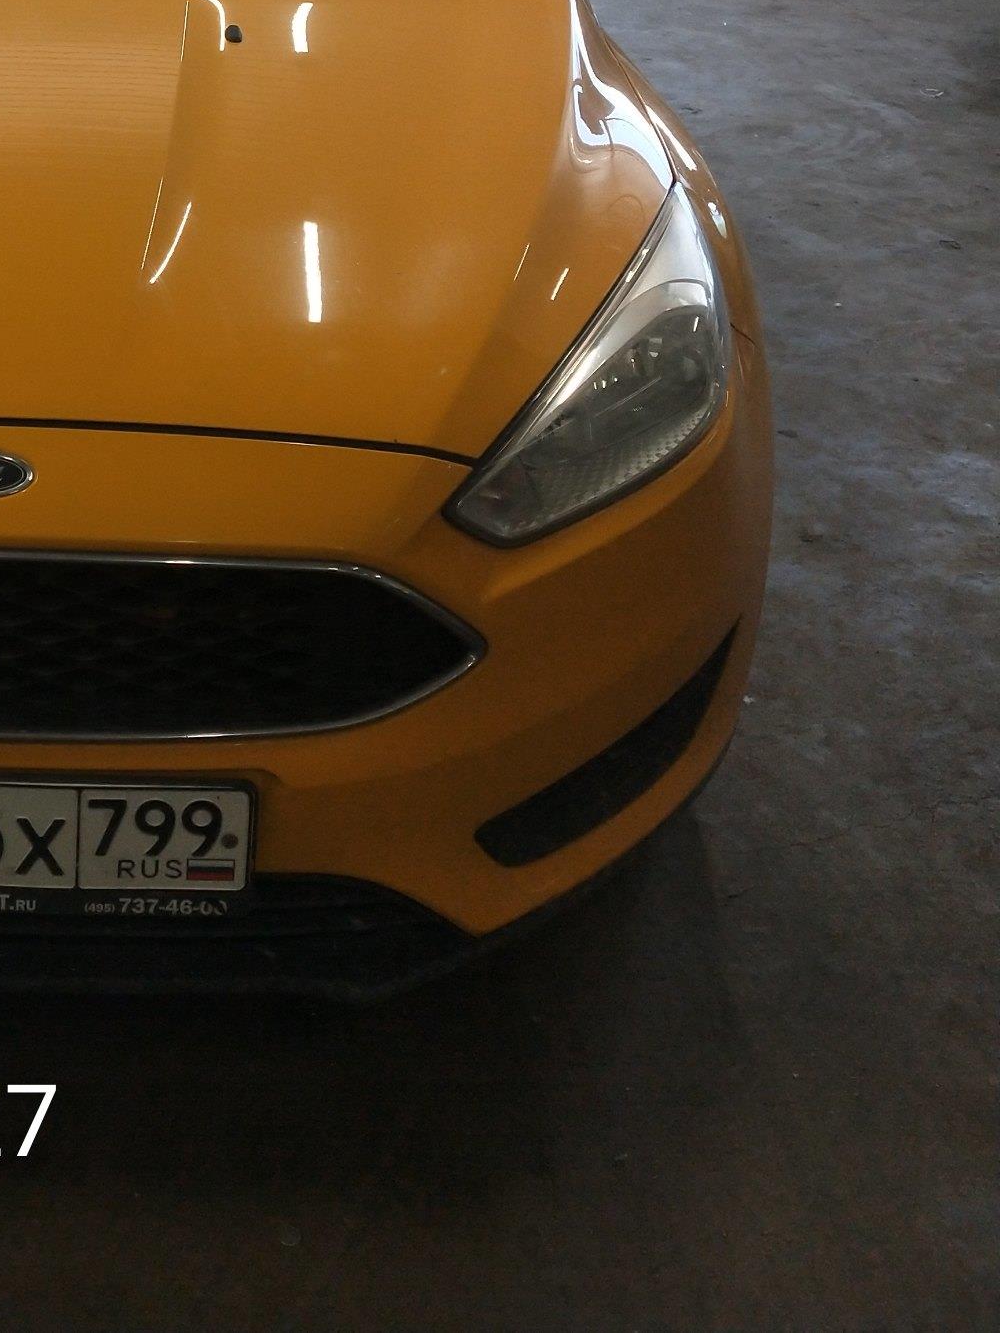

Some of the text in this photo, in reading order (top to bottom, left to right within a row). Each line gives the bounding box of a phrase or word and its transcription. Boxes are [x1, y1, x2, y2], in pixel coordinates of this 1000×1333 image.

[86, 798, 223, 857] 799
[117, 858, 183, 880] RUS
[84, 901, 115, 914] (495)
